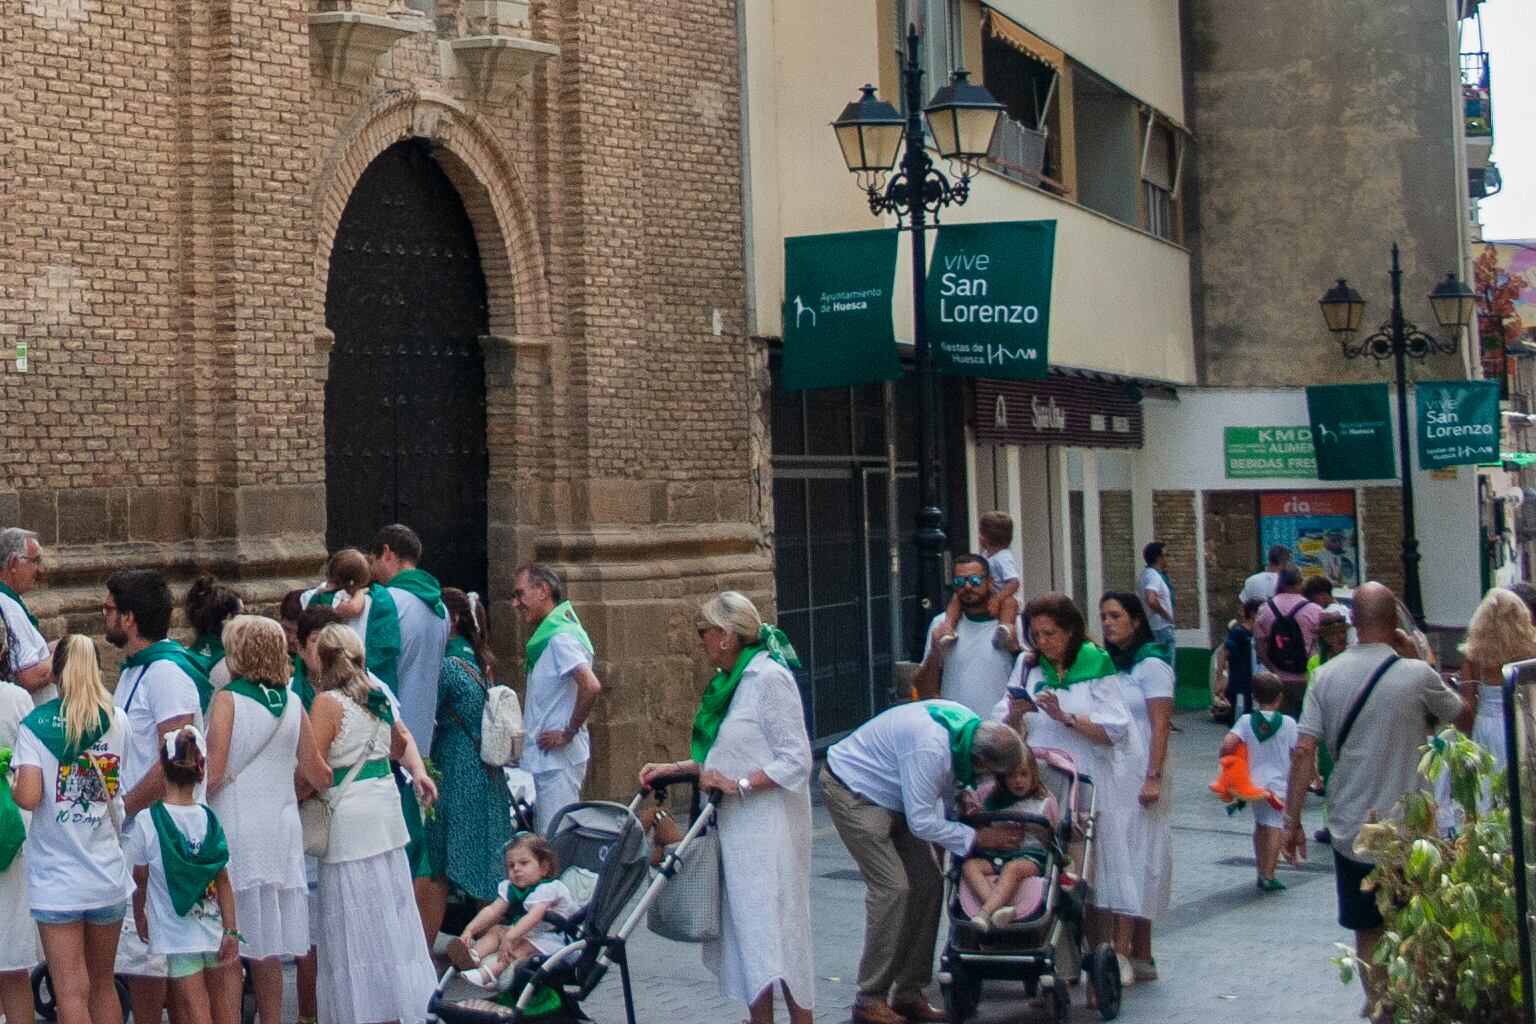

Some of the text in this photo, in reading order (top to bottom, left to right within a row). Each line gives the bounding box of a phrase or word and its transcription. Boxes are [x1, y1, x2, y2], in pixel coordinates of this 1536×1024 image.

[944, 248, 990, 271] vive
[940, 272, 988, 296] San
[833, 301, 868, 312] Huesca
[940, 298, 1039, 324] Lorenzo
[1426, 410, 1459, 424] San
[1426, 424, 1494, 439] Lorenzo
